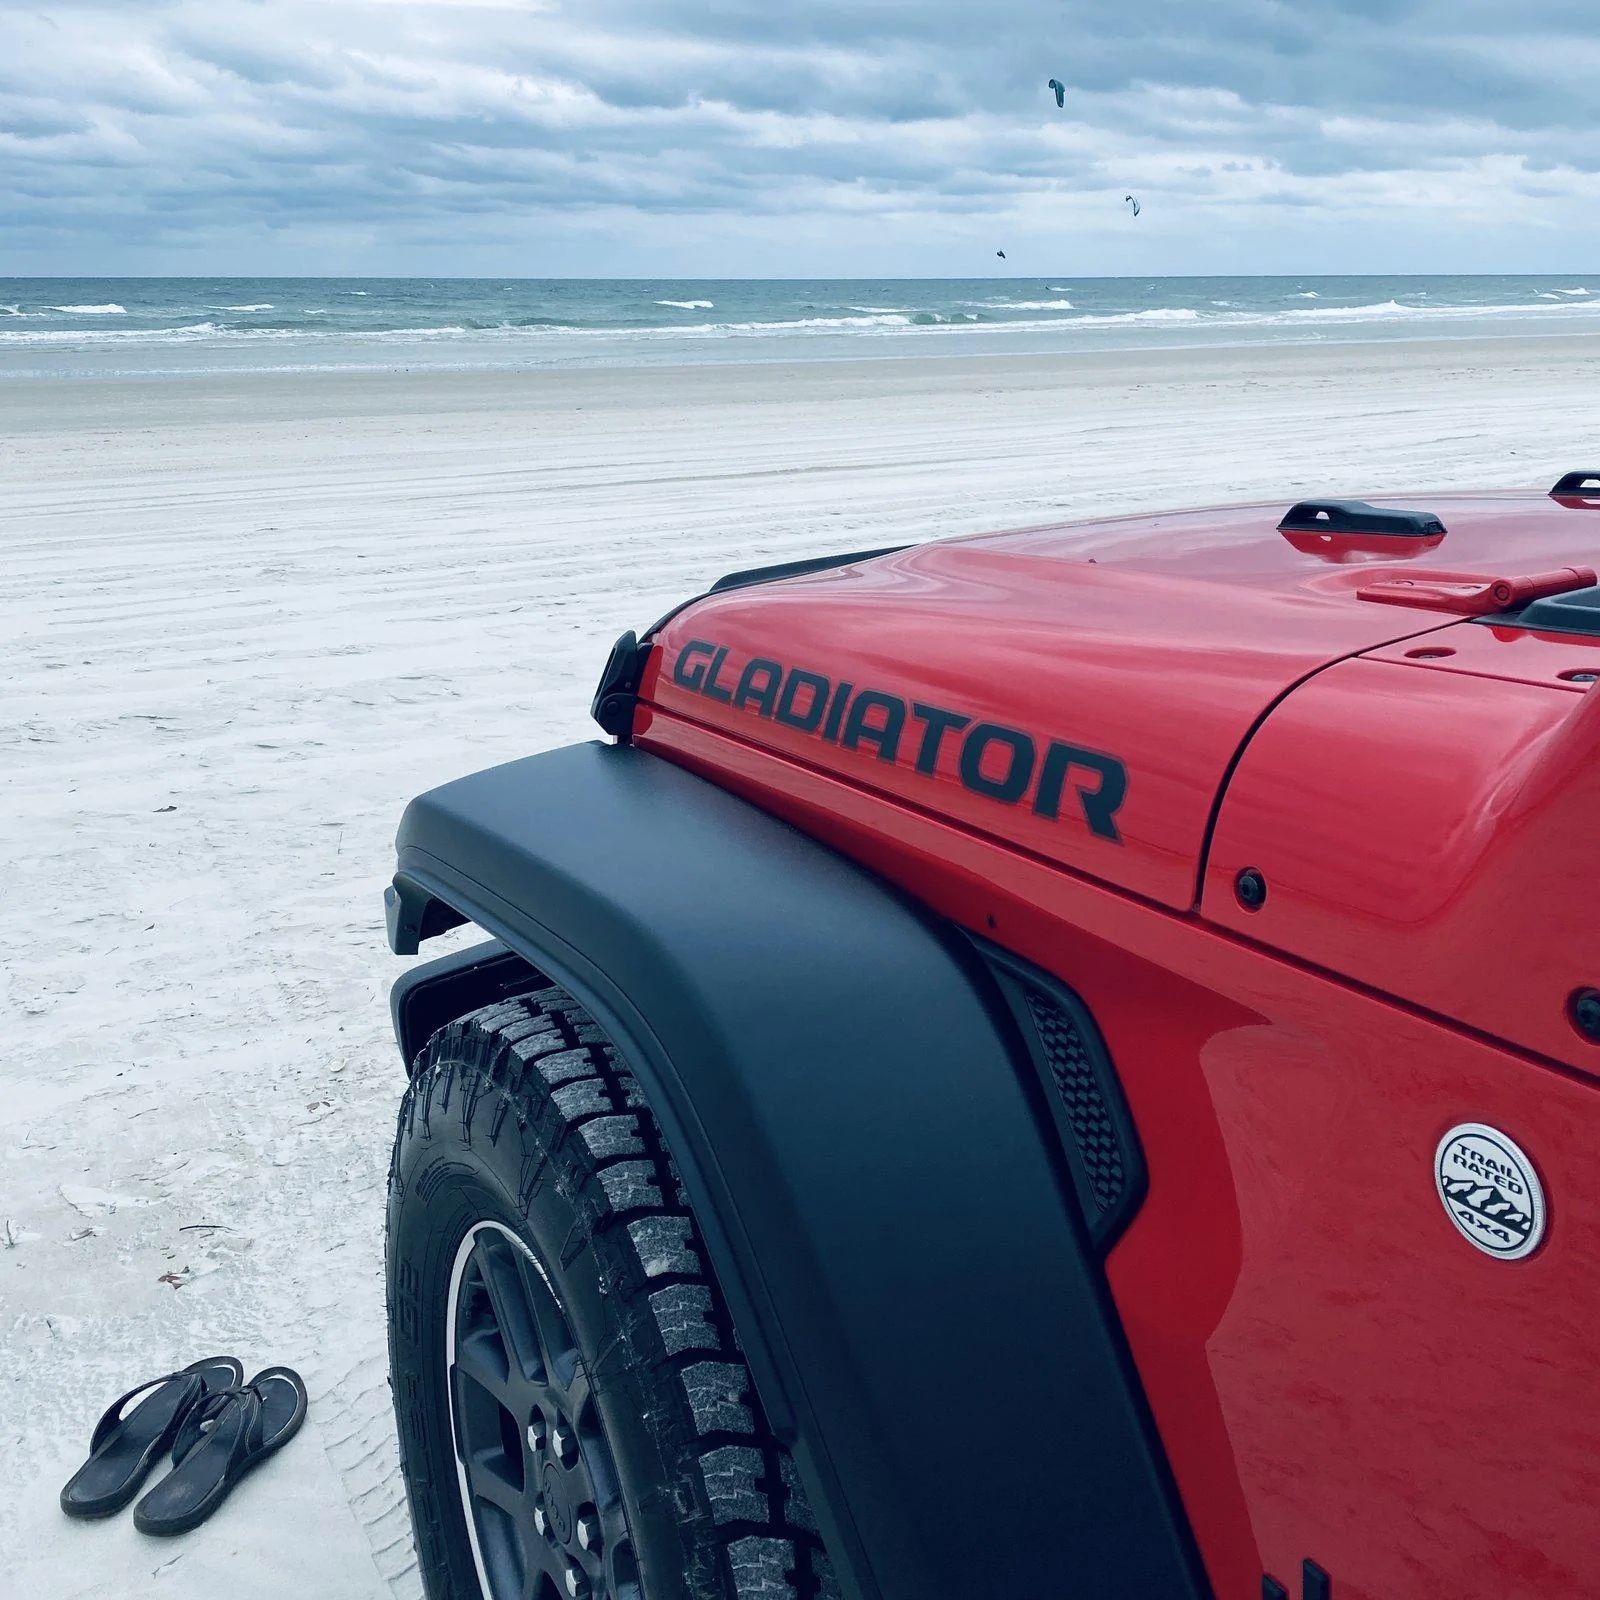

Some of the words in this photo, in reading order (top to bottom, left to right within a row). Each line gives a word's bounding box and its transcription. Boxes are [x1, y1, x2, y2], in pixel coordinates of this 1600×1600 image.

[673, 639, 1128, 843] GLADIATOR
[1453, 1153, 1523, 1195] RATED
[1457, 1143, 1518, 1181] TRAIL
